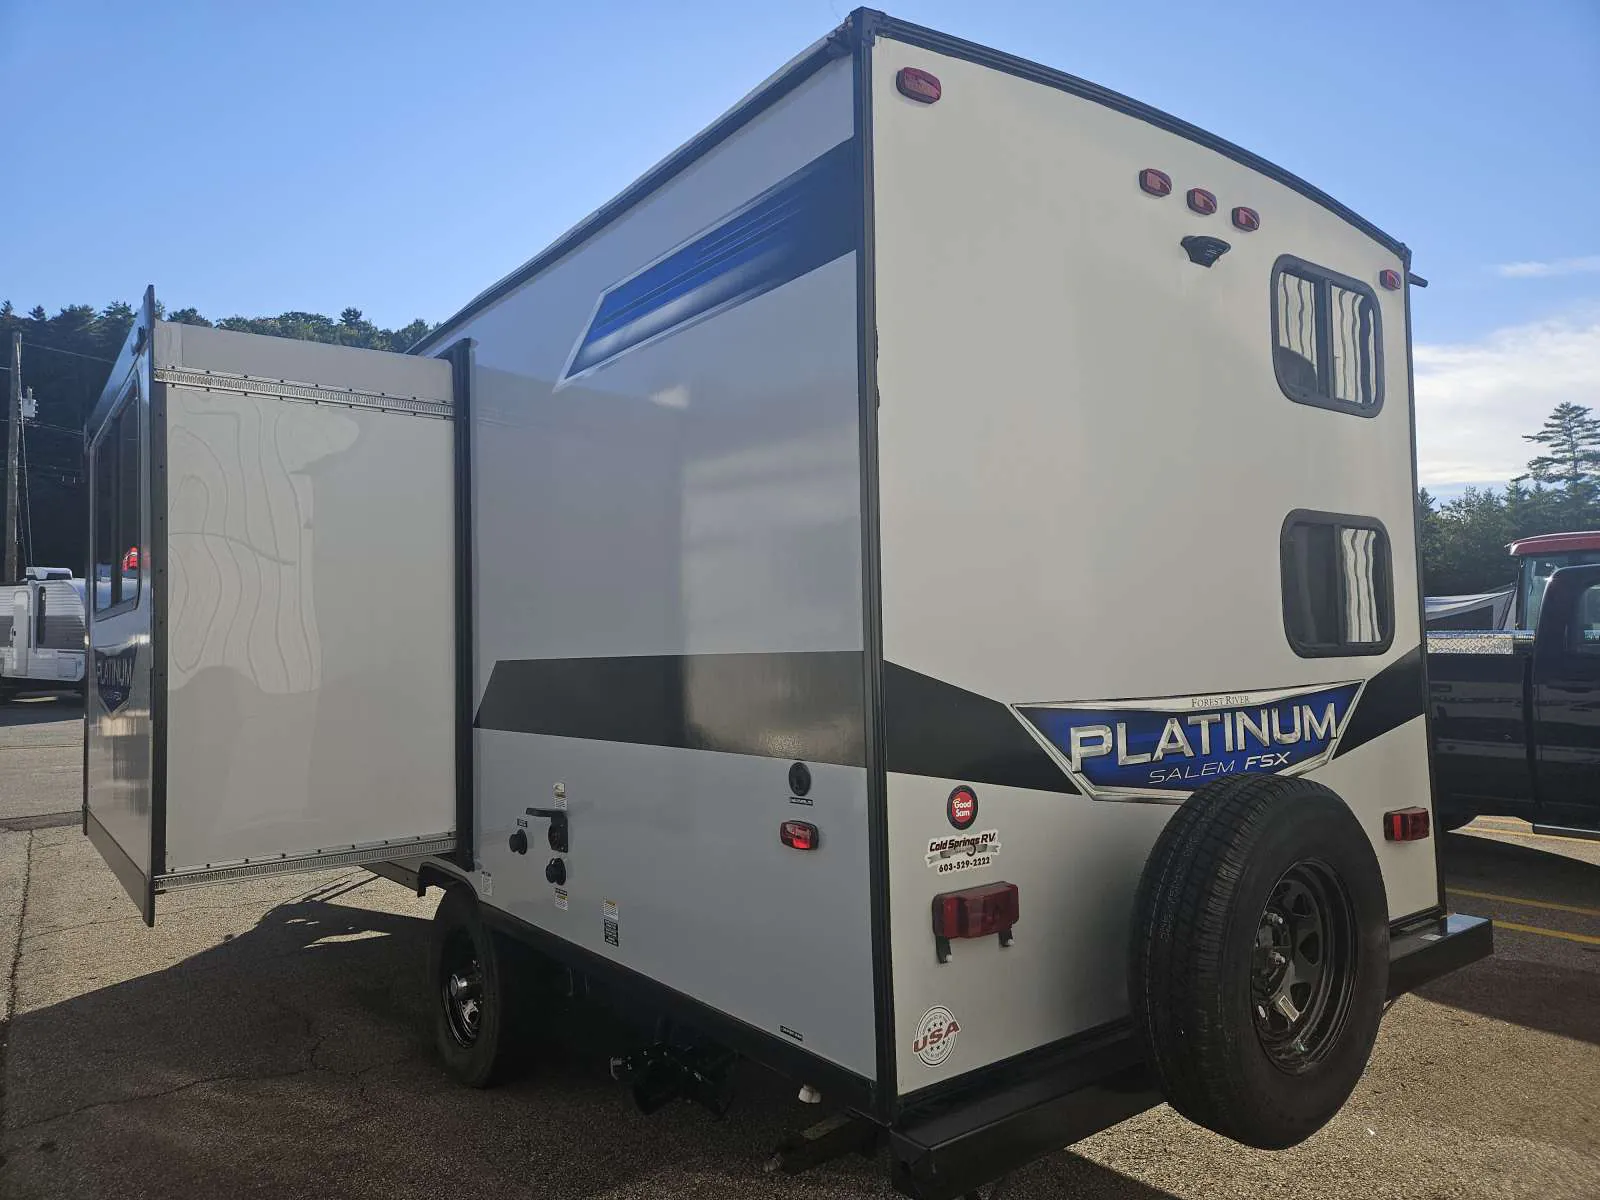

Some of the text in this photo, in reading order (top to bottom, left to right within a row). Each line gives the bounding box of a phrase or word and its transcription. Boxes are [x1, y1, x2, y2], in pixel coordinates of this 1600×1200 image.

[1191, 694, 1250, 708] FOREST RIVER
[1070, 703, 1337, 773] PLATINUM
[1148, 760, 1236, 784] SALEM
[954, 800, 972, 809] Good
[955, 809, 970, 817] Sam
[929, 839, 948, 852] Cold
[948, 836, 980, 857] Springs
[981, 832, 996, 843] RV
[938, 856, 990, 873] 603-529-2222
[913, 1021, 960, 1053] USA
